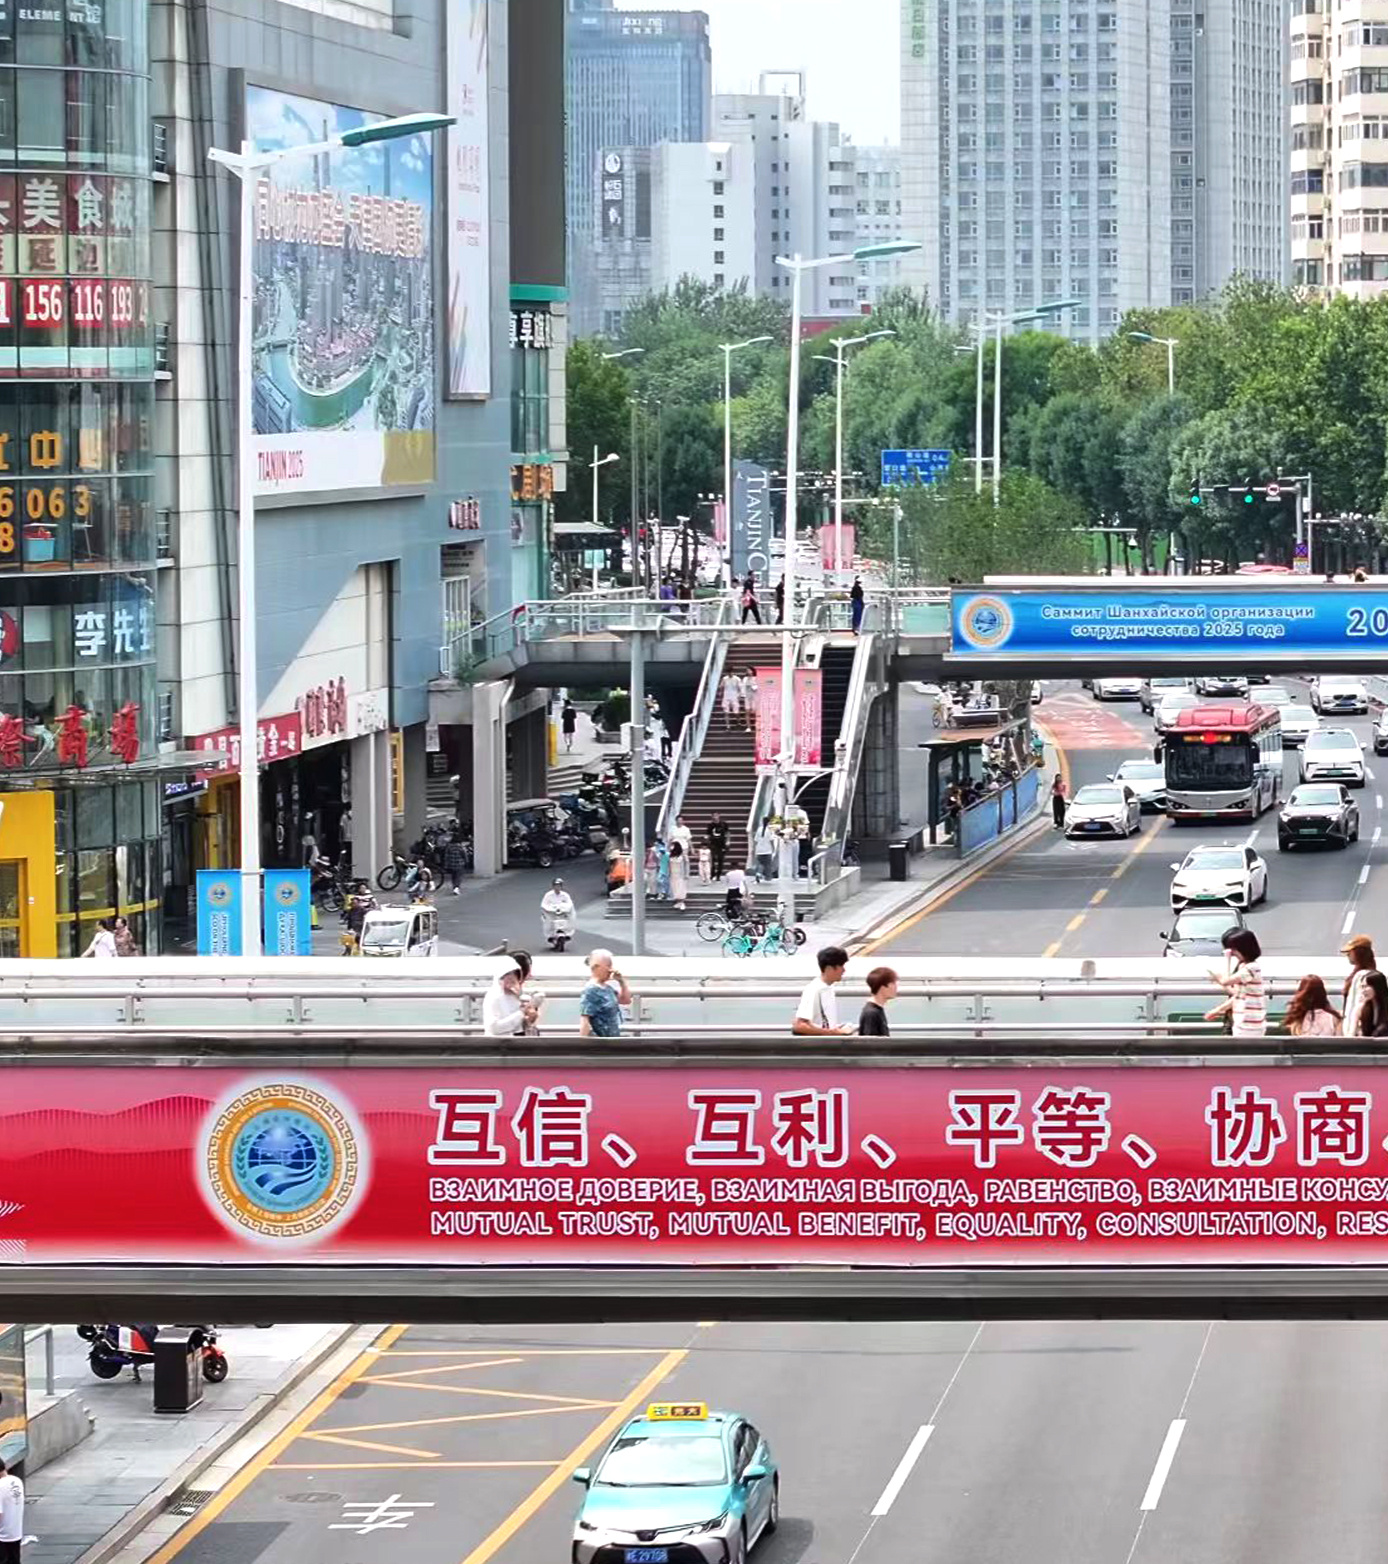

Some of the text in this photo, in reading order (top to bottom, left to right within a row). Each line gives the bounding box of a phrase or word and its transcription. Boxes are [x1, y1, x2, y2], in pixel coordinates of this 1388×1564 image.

[25, 284, 62, 322] 156
[74, 285, 103, 321] 116
[111, 285, 132, 322] 193
[746, 470, 769, 550] TIANJIN
[1041, 604, 1315, 623] Саммит Шанхайской организации
[1071, 622, 1285, 640] сотрудничества 2025 года
[429, 1177, 574, 1202] ВЗАИМНОЕ
[578, 1177, 706, 1206] ДОВЕРИЕ,
[711, 1177, 855, 1202] ВЗАИМНАЯ
[860, 1177, 978, 1206] ВЫГОДА,
[984, 1177, 1142, 1206] РАВЕНСТВО,
[1148, 1177, 1298, 1202] ВЗАИМНЫЕ
[430, 1211, 552, 1237] MUTUAL
[558, 1211, 660, 1240] TRUST,
[668, 1211, 790, 1237] MUTUAL
[797, 1211, 926, 1240] BENEFIT,
[934, 1211, 1087, 1240] EQUALITY,
[1096, 1210, 1328, 1239] CONSULTATION,
